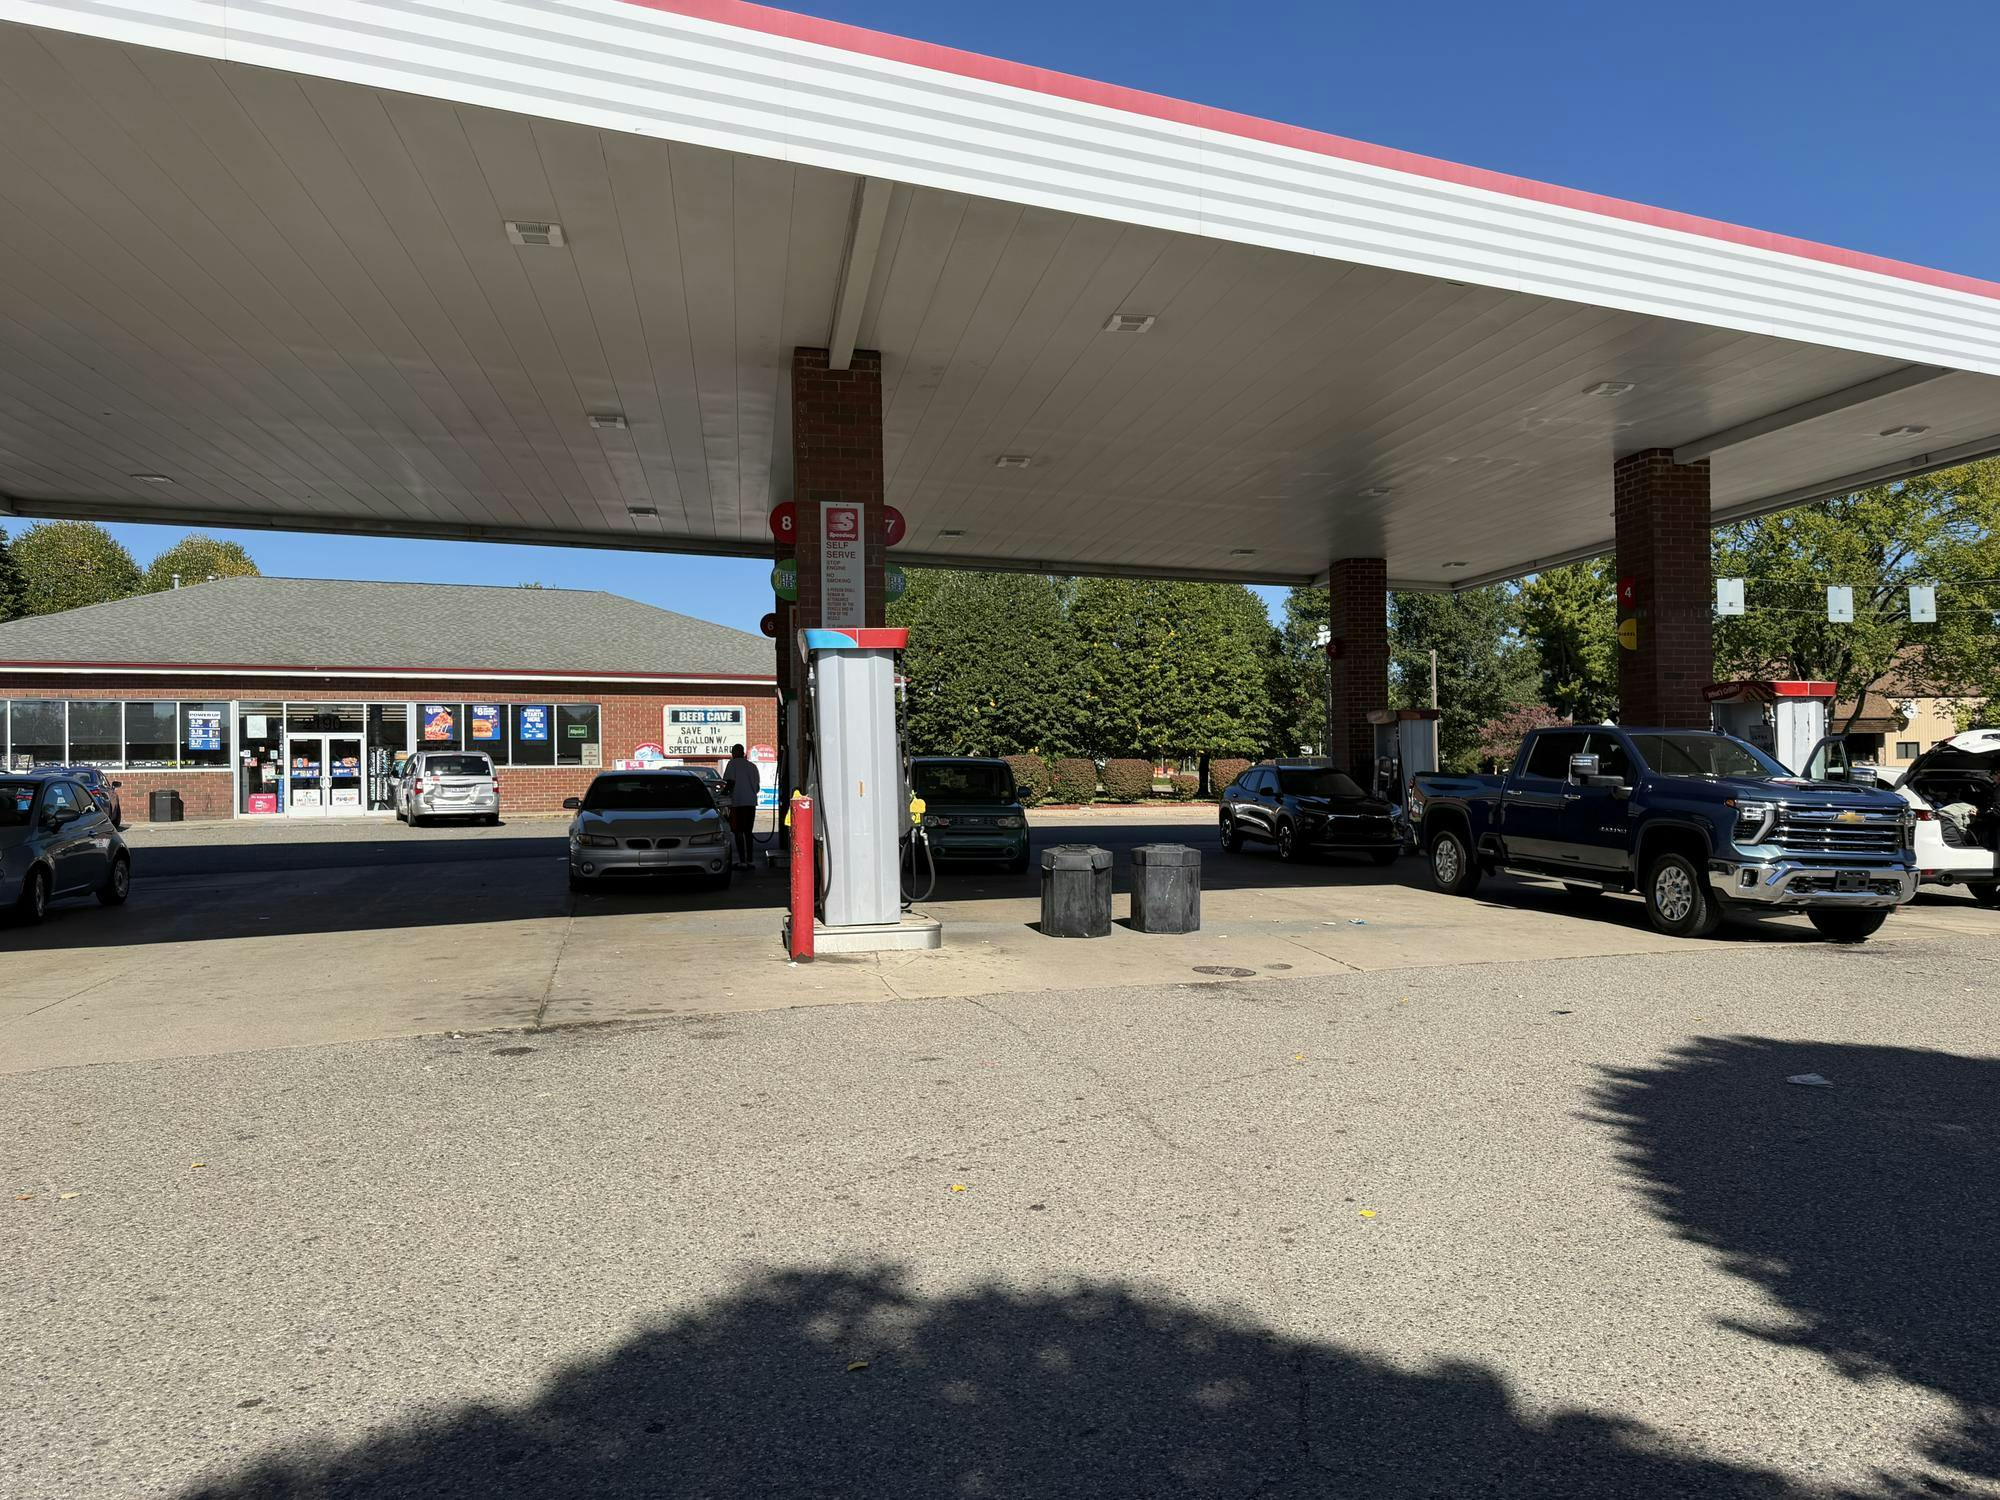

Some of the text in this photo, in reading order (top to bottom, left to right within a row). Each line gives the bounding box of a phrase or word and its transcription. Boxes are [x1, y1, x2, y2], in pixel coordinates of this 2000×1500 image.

[781, 515, 793, 531] 8
[884, 519, 896, 534] 7
[826, 541, 849, 550] SELF
[826, 550, 856, 559] SERVE
[1624, 586, 1632, 598] 4
[766, 621, 775, 631] 6
[679, 711, 733, 722] BEER CAVE
[681, 726, 702, 735] SAVE
[677, 736, 683, 744] A
[684, 736, 714, 744] GALLON
[669, 745, 698, 754] SPEEDY
